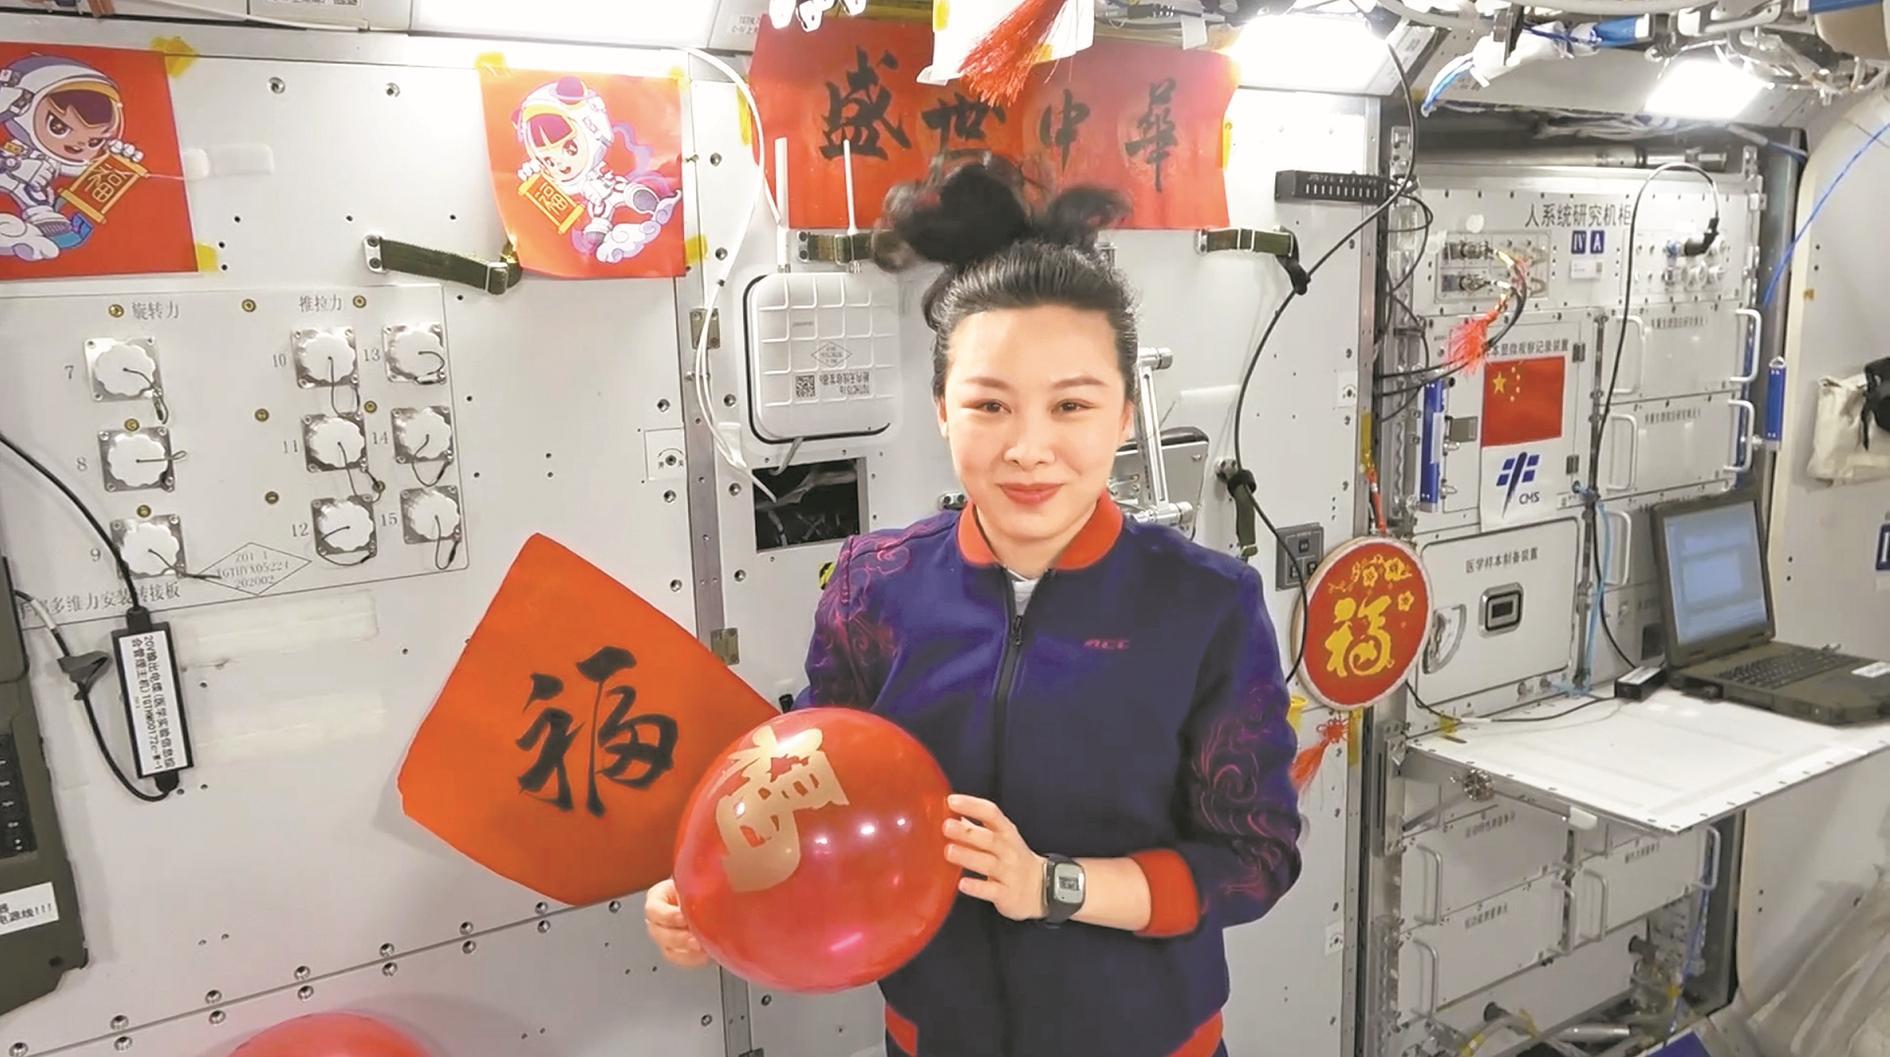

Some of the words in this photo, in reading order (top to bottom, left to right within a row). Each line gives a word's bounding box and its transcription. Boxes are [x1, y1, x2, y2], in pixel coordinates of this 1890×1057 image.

[85, 163, 134, 203] 福
[534, 182, 569, 217] 福
[1525, 203, 1631, 227] 人系统研究机柜
[299, 295, 342, 312] 推拉力
[131, 302, 180, 320] 旋转力
[273, 353, 287, 367] 10
[363, 348, 381, 362] 13
[64, 365, 74, 379] 7
[372, 432, 389, 444] 14
[283, 440, 298, 454] 11
[77, 456, 88, 471] 8
[1519, 491, 1540, 505] CMS
[381, 513, 398, 527] 15
[292, 523, 309, 537] 12
[90, 548, 101, 562] 9
[1324, 595, 1396, 678] 福
[515, 645, 679, 819] 福
